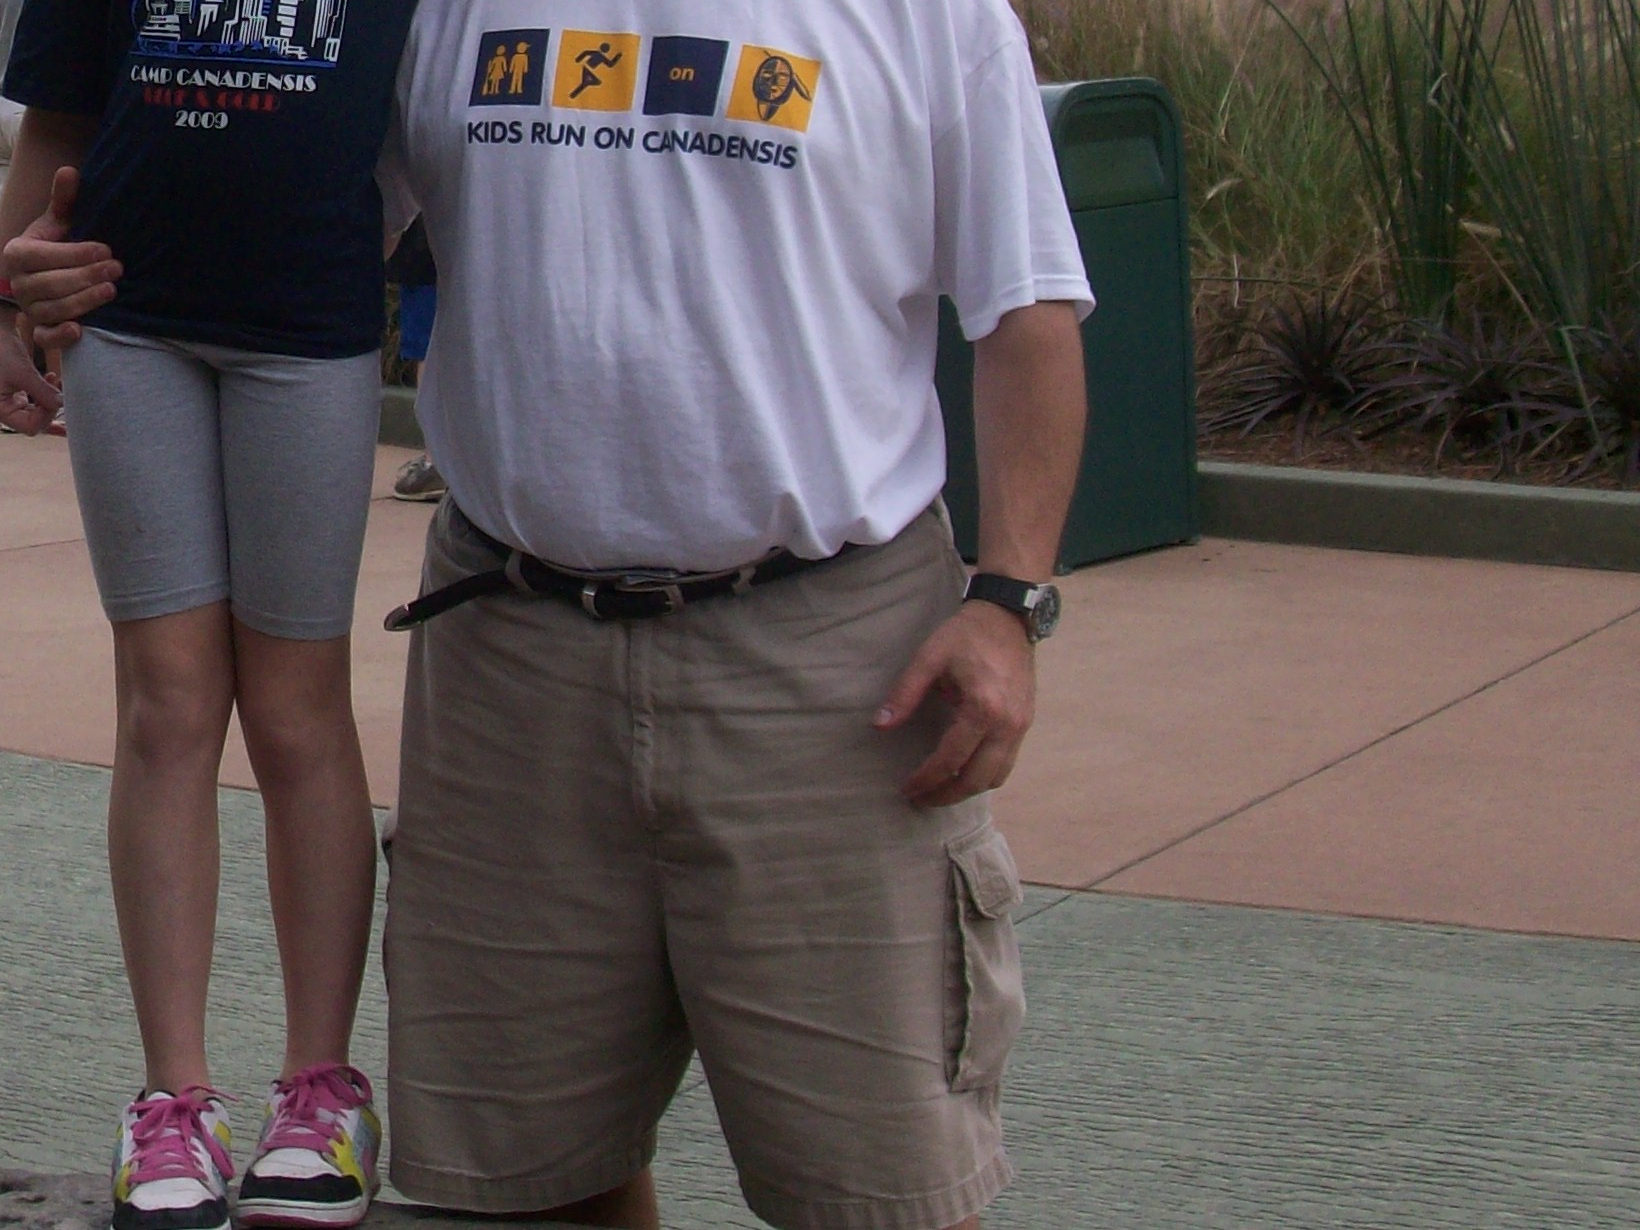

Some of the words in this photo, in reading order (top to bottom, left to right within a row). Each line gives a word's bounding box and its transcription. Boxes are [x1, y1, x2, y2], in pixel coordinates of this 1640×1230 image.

[130, 64, 173, 85] CAMP
[175, 68, 318, 93] CANADENSIS
[668, 66, 696, 82] on
[174, 109, 230, 130] 2009
[467, 120, 524, 145] KIDS
[530, 122, 586, 149] RUN
[593, 126, 635, 151] ON
[641, 130, 799, 171] CANADENSIS
